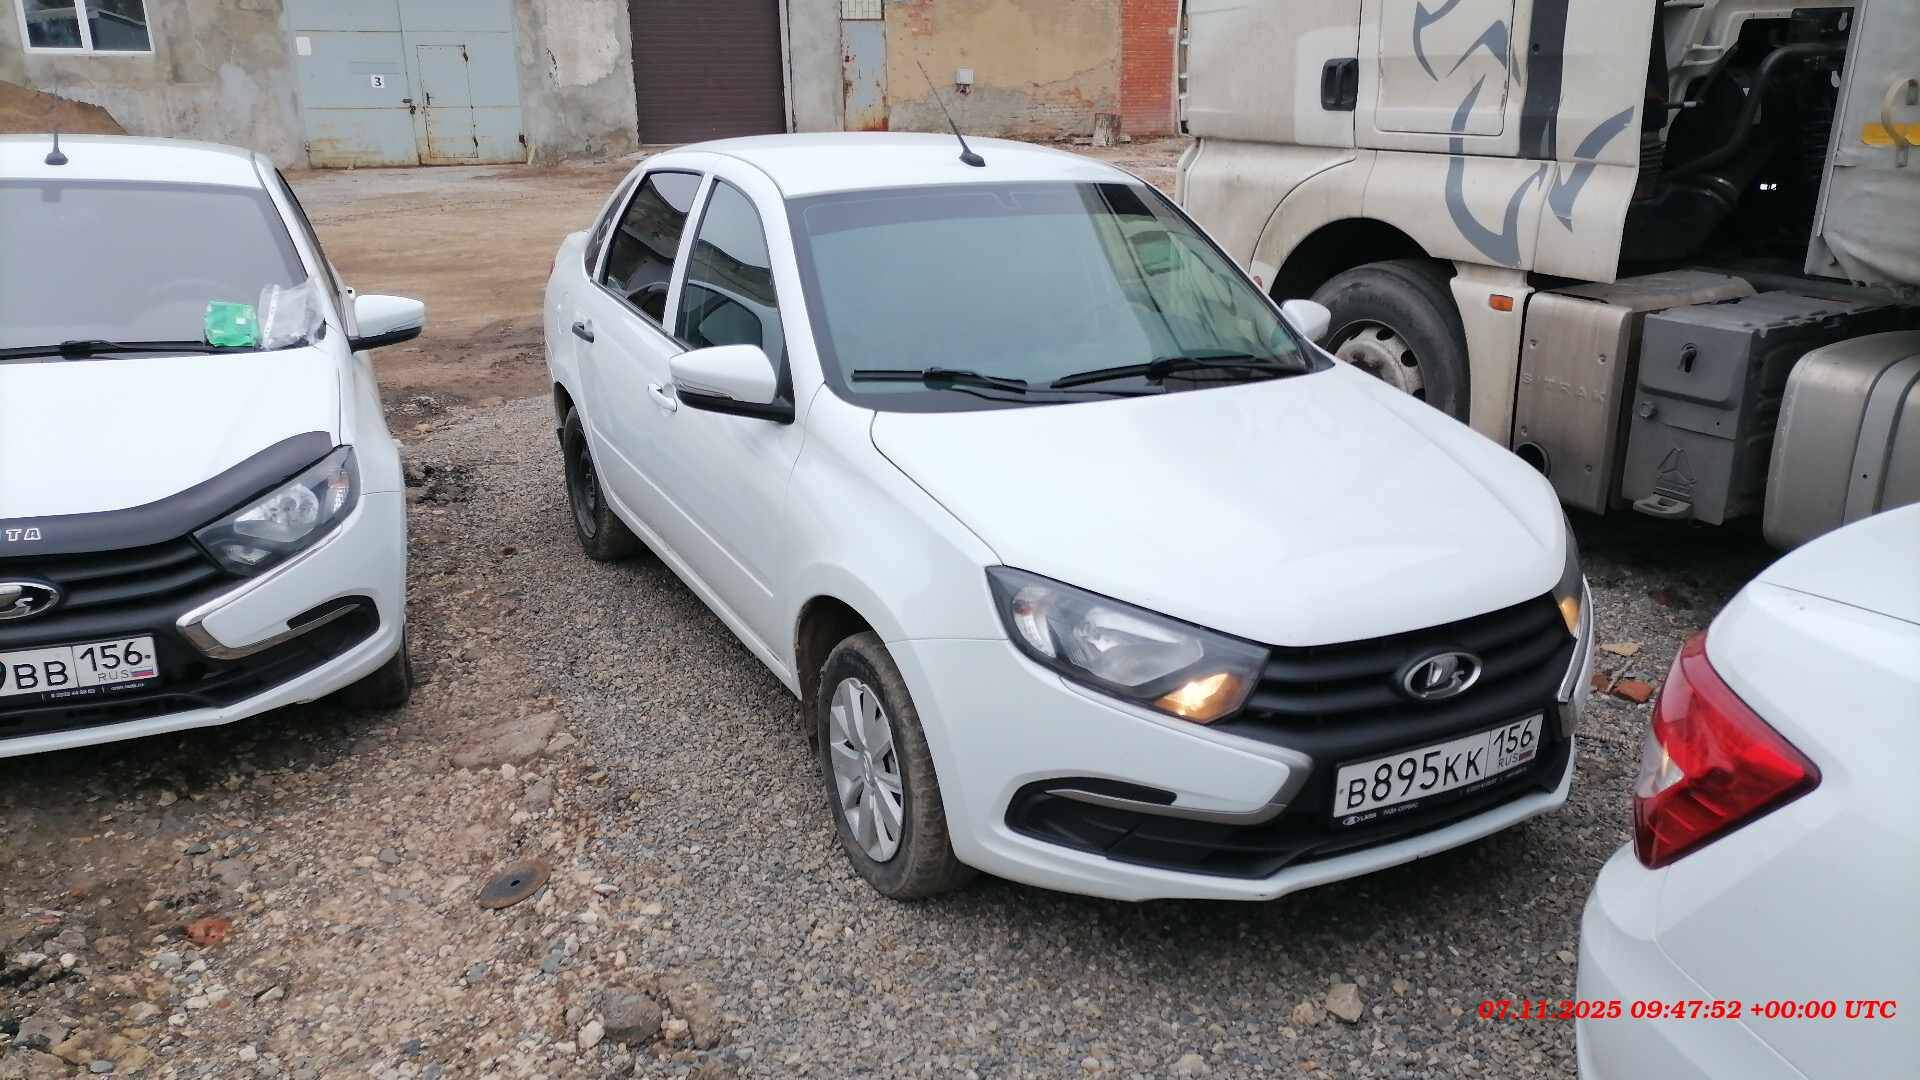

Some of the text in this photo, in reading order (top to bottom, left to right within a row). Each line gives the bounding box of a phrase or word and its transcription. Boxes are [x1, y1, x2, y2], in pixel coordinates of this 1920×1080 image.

[374, 76, 382, 87] 3
[79, 641, 143, 671] 156
[97, 669, 129, 682] RUS
[1347, 719, 1533, 809] В895КК 156
[1497, 752, 1520, 768] RUS
